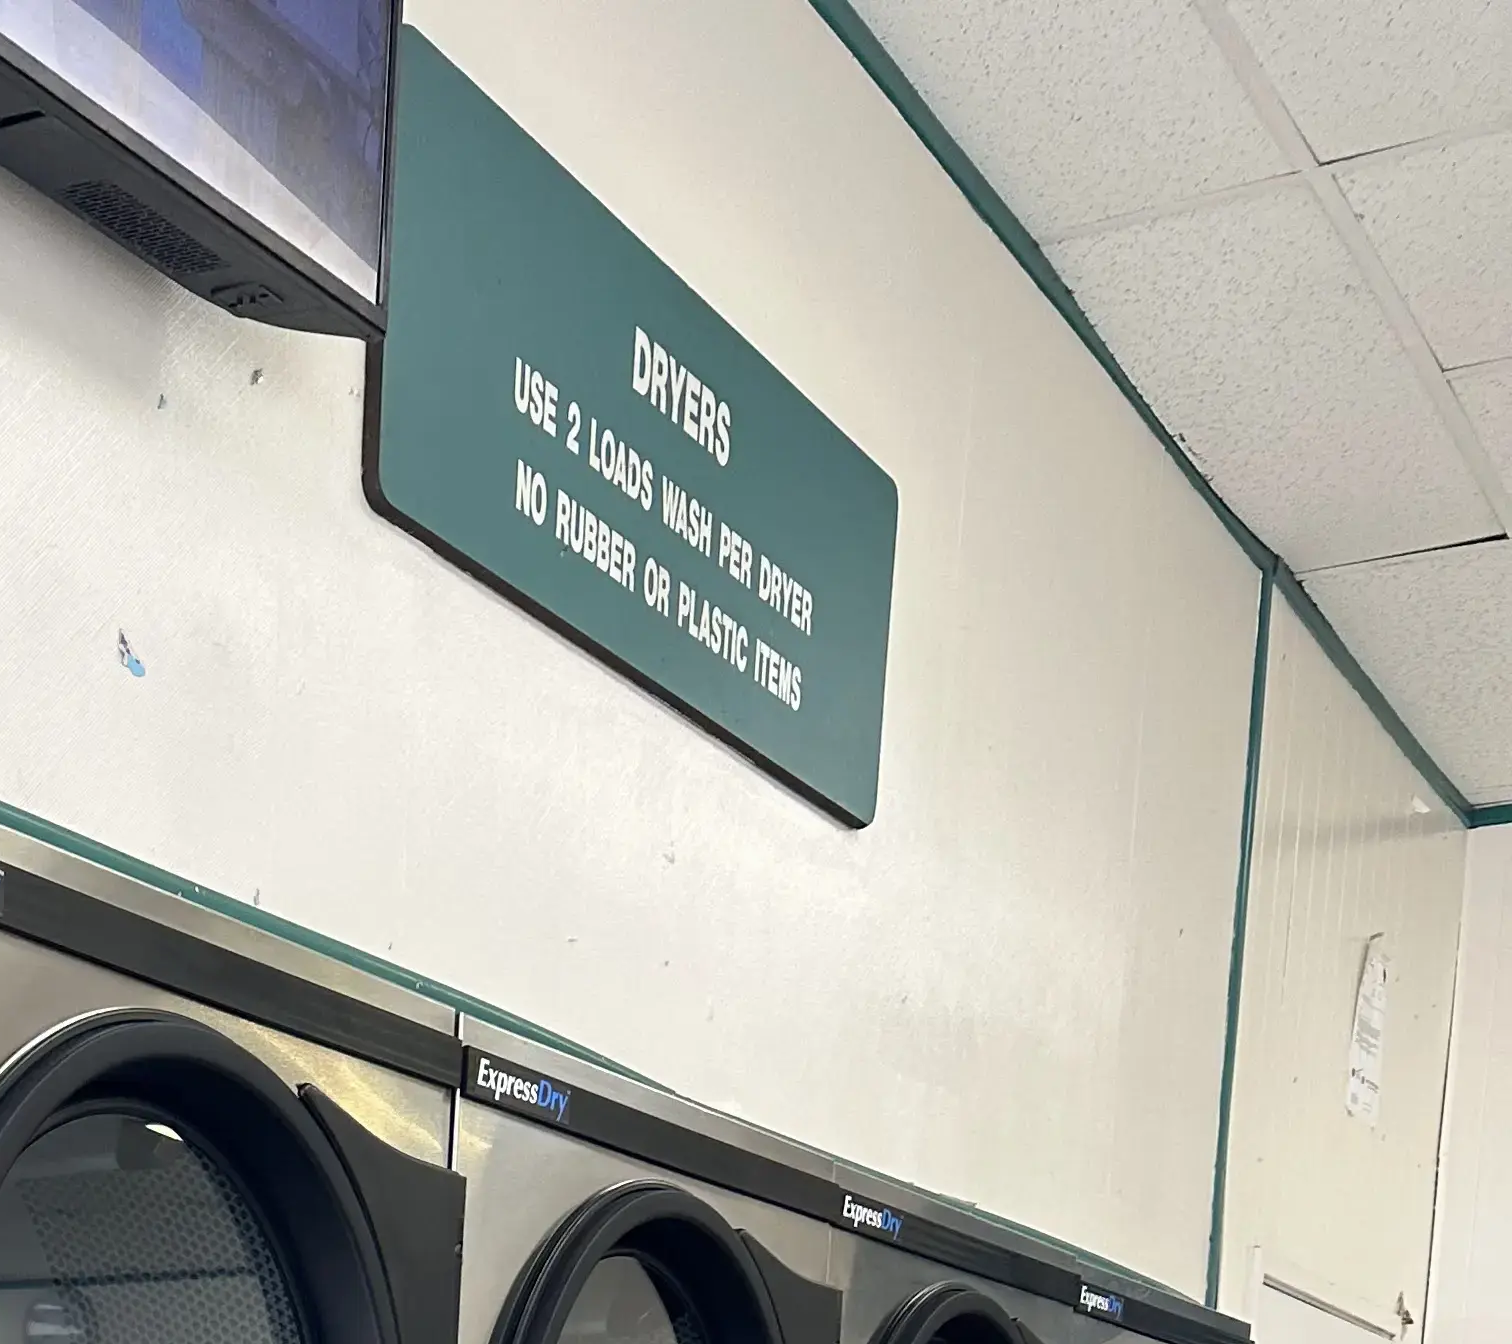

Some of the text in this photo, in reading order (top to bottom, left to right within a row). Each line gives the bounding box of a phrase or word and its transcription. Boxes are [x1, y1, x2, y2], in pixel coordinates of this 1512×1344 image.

[633, 326, 731, 466] DRYERS
[515, 357, 813, 636] USE 2 LOADS WASH PER DRYER
[515, 459, 802, 711] NO RUBBER OR PLASTIC ITEMS
[476, 1057, 568, 1122] ExpressDry
[842, 1194, 902, 1240] ExpressDry
